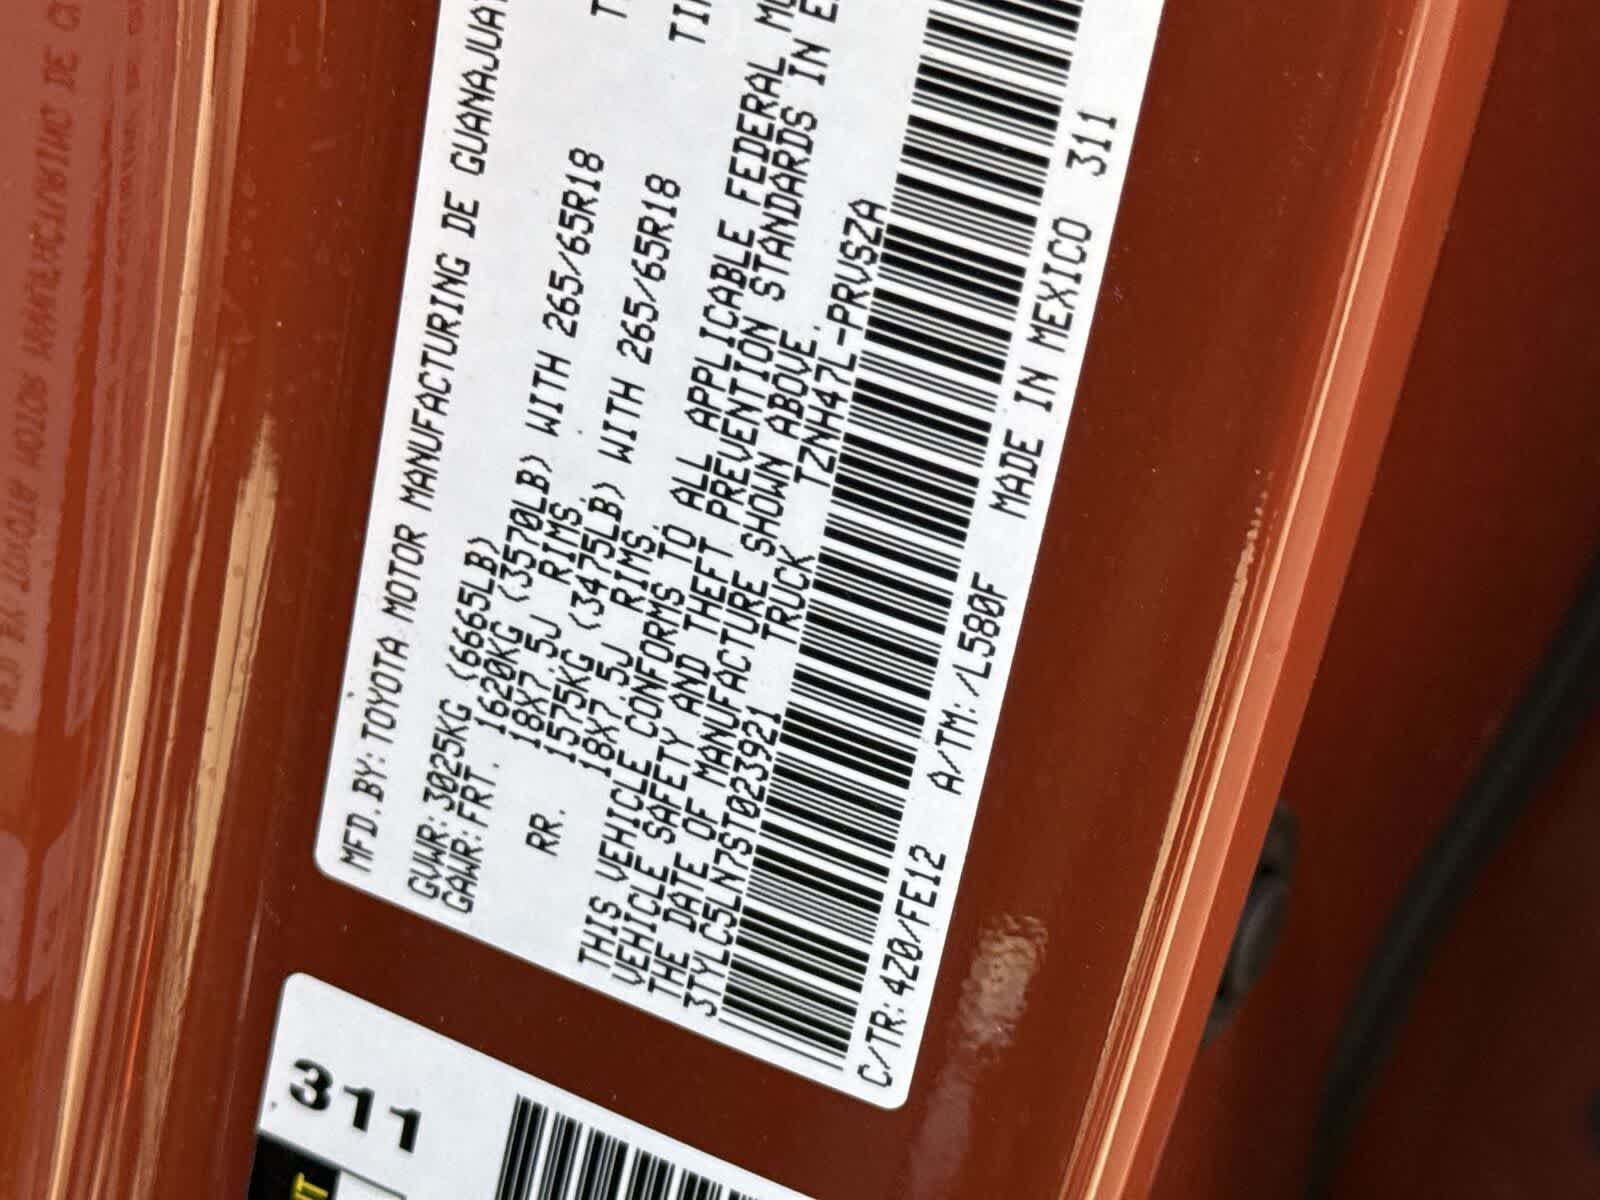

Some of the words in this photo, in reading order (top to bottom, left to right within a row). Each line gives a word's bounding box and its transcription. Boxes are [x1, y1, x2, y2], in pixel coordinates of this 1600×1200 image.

[668, 0, 712, 44] TI
[787, 38, 831, 86] IN
[449, 0, 508, 176] GUANAJUA
[724, 57, 786, 206] FEDERAL
[1066, 111, 1117, 176] 311
[441, 190, 479, 239] DE
[542, 147, 604, 338] 265/65R18
[748, 106, 818, 302] STANDARDS
[616, 173, 681, 365] 265/65R18
[684, 219, 756, 433] APPLICABLE
[1027, 217, 1092, 353] MEXICO
[399, 252, 471, 512] MANUFACTURING
[525, 350, 571, 437] WITH
[597, 377, 645, 465] WITH
[705, 315, 779, 526] PREVENTION
[764, 326, 820, 440] ABOVE.
[1013, 366, 1058, 412] IN
[497, 455, 553, 603] (3570LB)
[669, 454, 713, 512] ALL
[740, 451, 793, 558] SHOWN
[989, 429, 1044, 519] MADE
[382, 523, 427, 623] MOTOR
[568, 482, 625, 631] (3475LB)
[656, 524, 697, 564] TO
[682, 536, 734, 636] THEFT
[446, 536, 500, 681] (6665LB)
[508, 614, 562, 749] 18X7.5J
[537, 497, 586, 586] RIMS.
[578, 642, 634, 778] 18X7.5J
[609, 525, 659, 614] RIMS.
[624, 582, 686, 739] CONFORMS
[682, 705, 782, 1017] 3TYLC5LN7ST023921
[760, 544, 815, 645] TRUCK
[793, 198, 887, 488] TZNH47L-PRVSZA
[474, 620, 524, 735] 1620KG
[543, 648, 596, 764] 1575KG
[668, 653, 711, 718] AND
[692, 569, 769, 788] MANUFACTURE
[525, 810, 565, 857] RR.
[595, 749, 653, 882] VEHICLE
[641, 726, 695, 845] SAFETY
[681, 796, 718, 841] OF
[577, 895, 622, 969] THIS
[612, 855, 670, 986] VEHICLE
[662, 851, 710, 934] DATE
[647, 941, 690, 999] THE
[289, 1059, 421, 1153] 311
